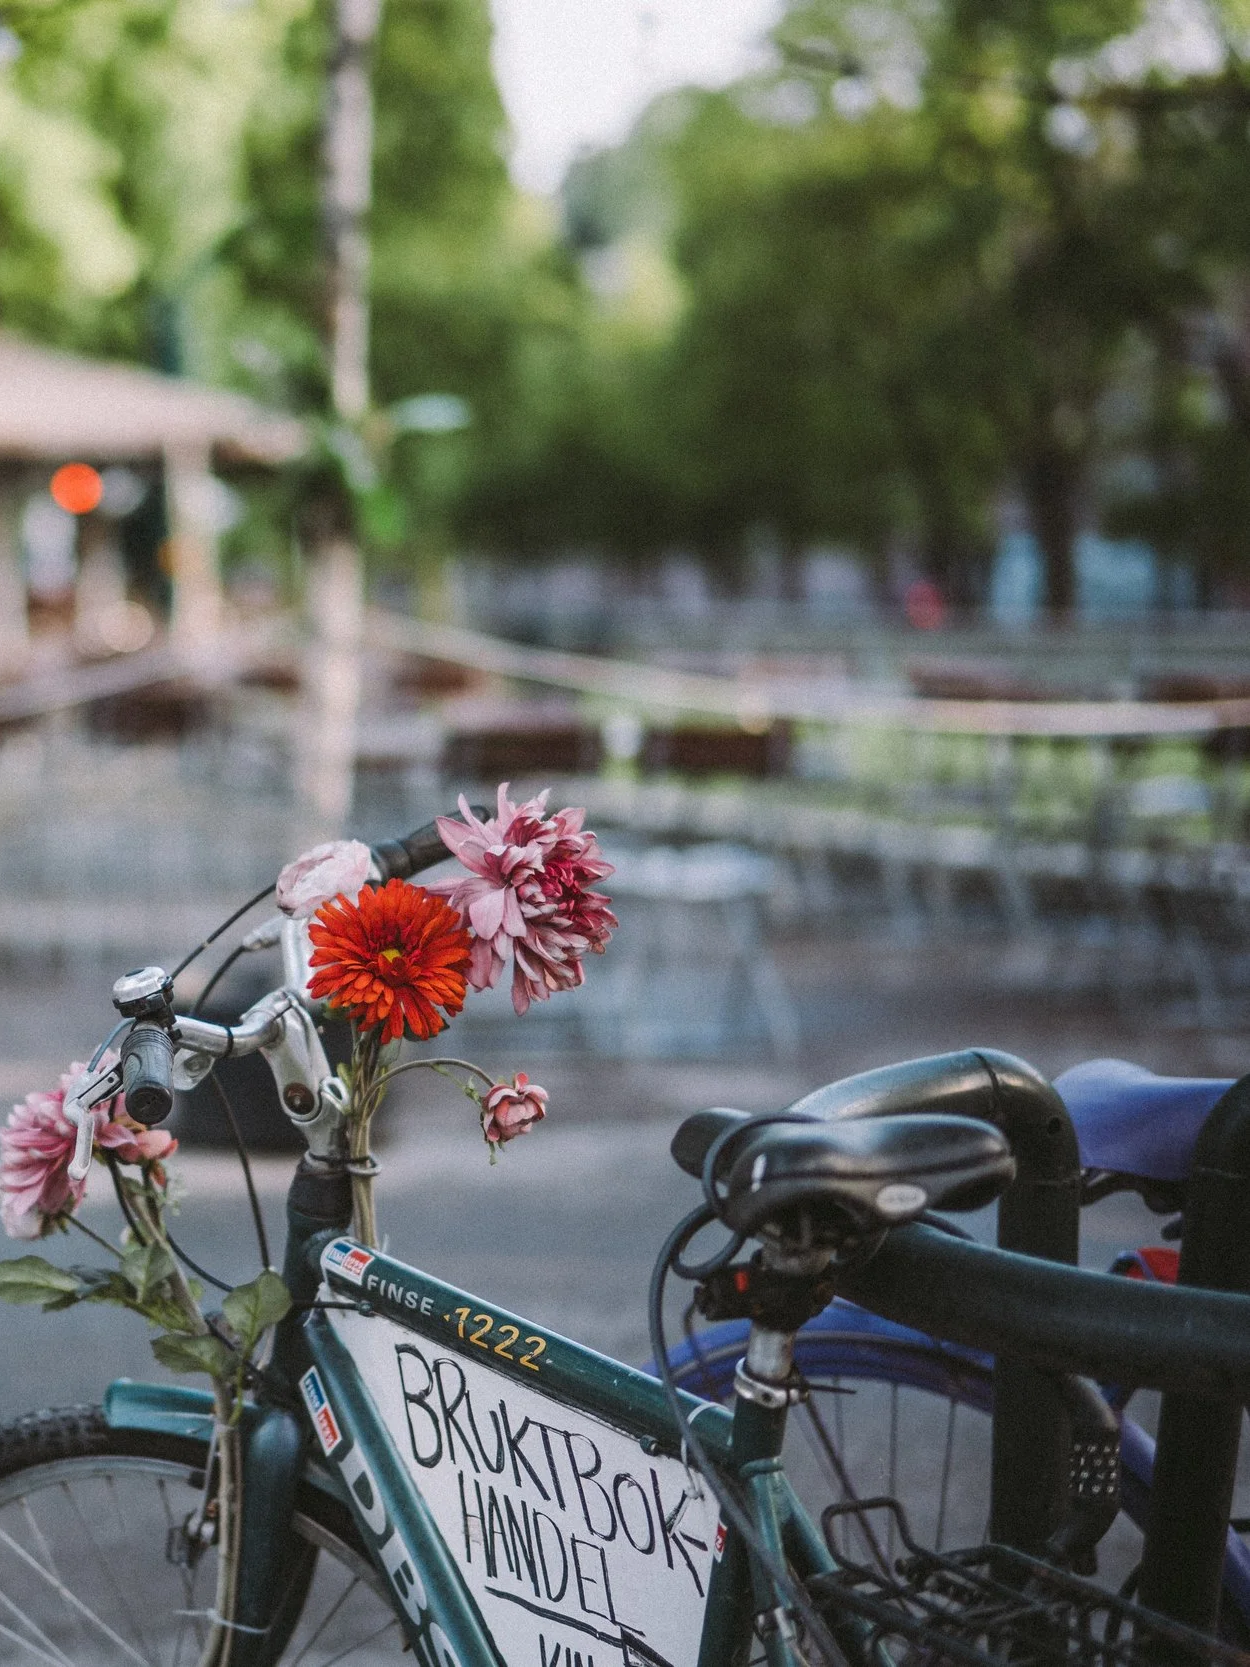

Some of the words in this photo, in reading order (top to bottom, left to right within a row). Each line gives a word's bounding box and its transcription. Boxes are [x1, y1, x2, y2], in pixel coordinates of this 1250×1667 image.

[366, 1274, 435, 1316] FINSE
[454, 1307, 547, 1371] 1222
[458, 1470, 646, 1637] HANDEL
